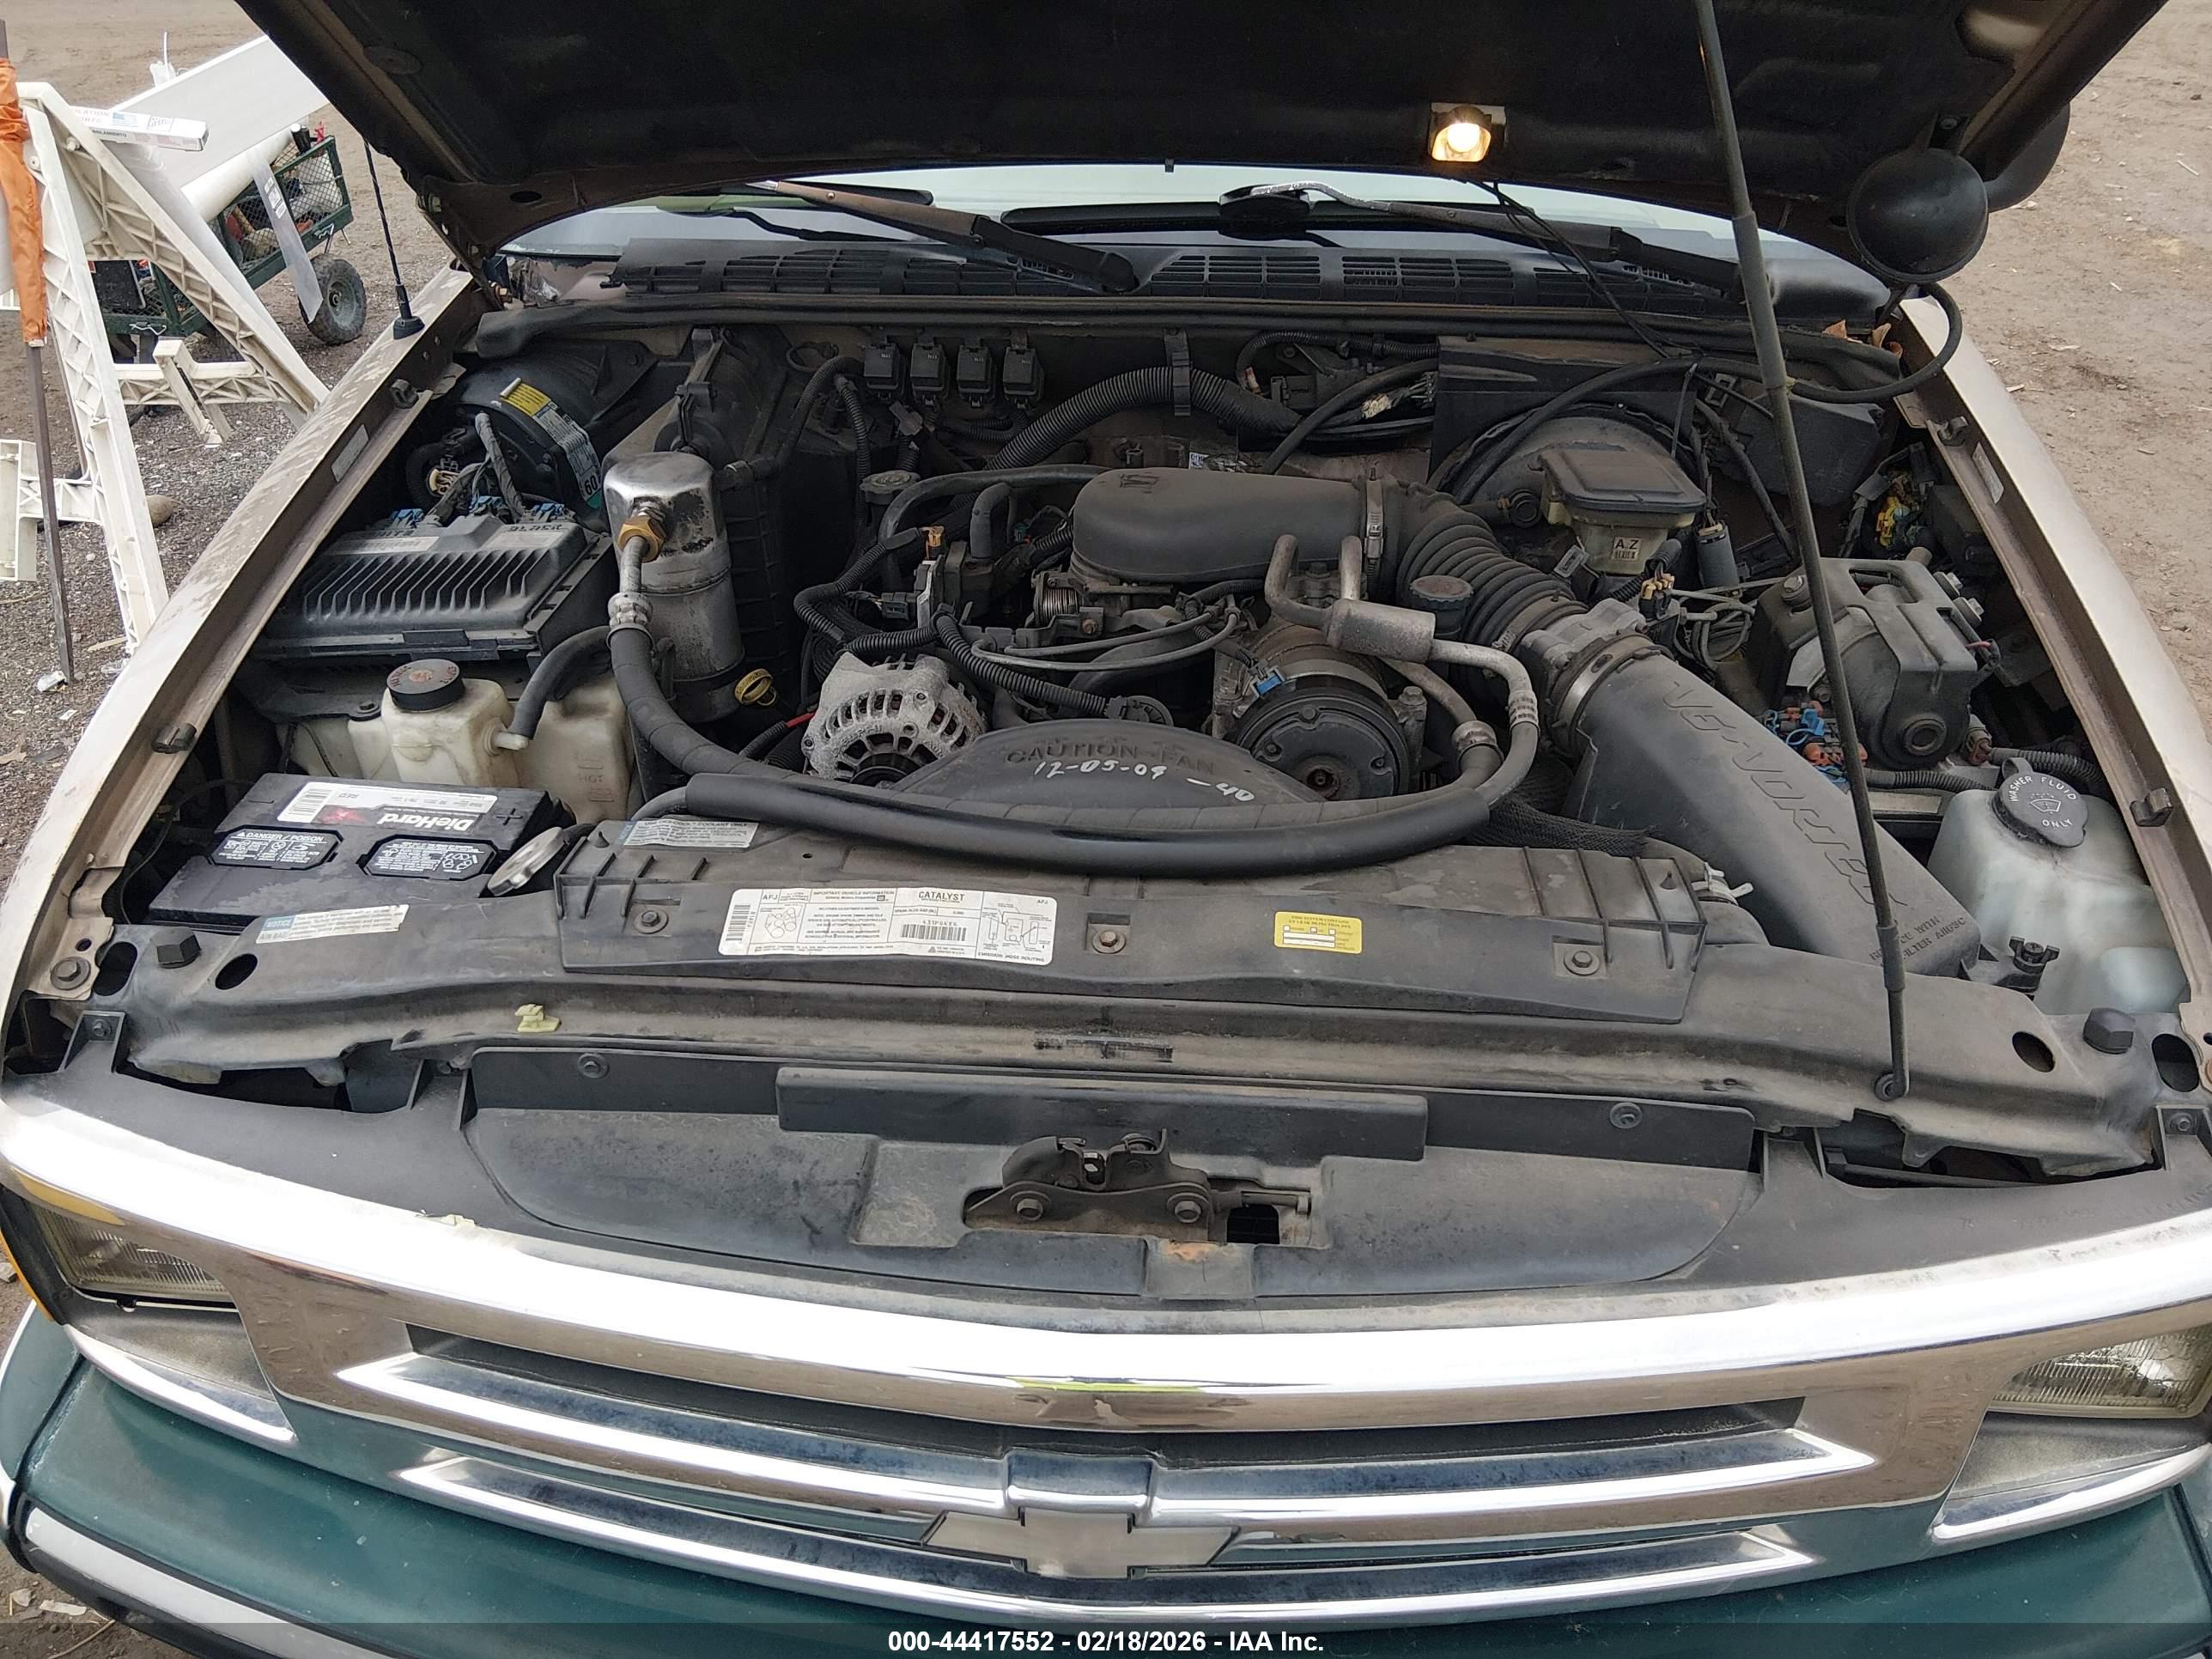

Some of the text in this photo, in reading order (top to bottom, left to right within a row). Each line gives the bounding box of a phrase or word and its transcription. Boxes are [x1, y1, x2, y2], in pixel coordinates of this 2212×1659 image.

[2008, 775, 2077, 803] WASHER FLUID
[377, 812, 475, 832] DieHard
[2042, 818, 2074, 829] ONLY
[246, 831, 283, 841] DANGER
[918, 890, 966, 902] CATALYST
